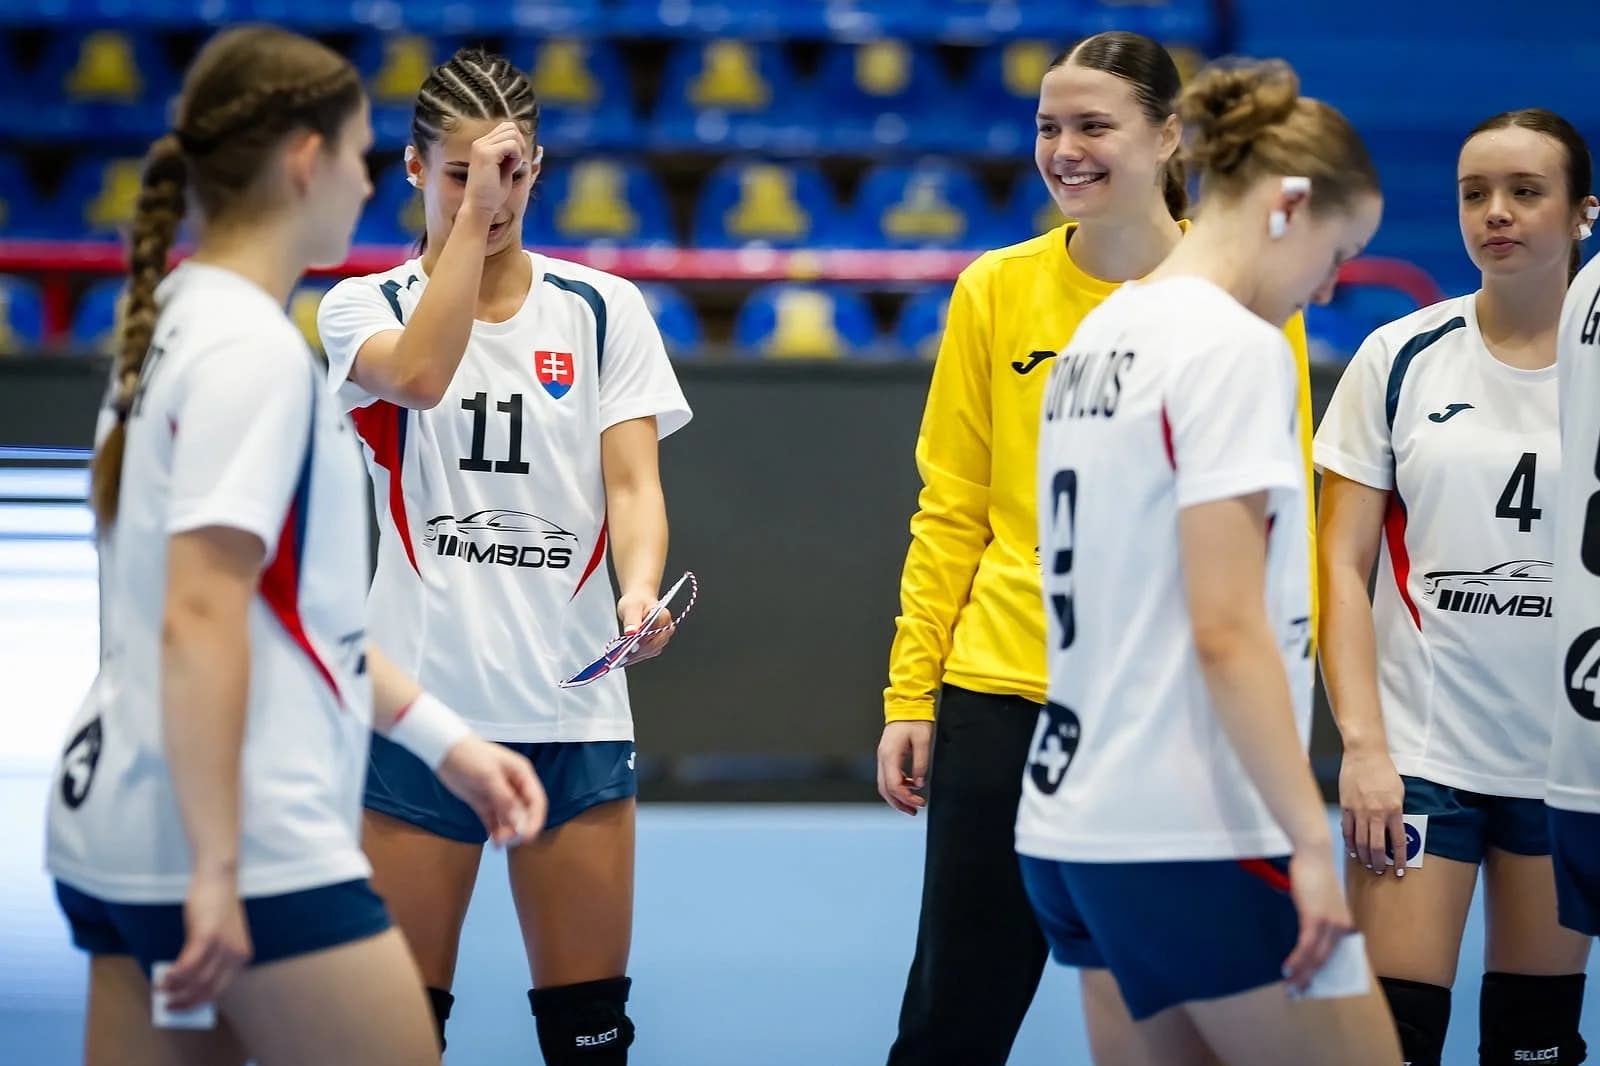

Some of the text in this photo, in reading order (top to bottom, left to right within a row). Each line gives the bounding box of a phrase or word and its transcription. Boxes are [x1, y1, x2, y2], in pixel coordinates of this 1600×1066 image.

[459, 392, 529, 474] 11
[1495, 452, 1541, 533] 4
[467, 541, 573, 569] MBDS
[1483, 593, 1552, 618] MB
[576, 1027, 618, 1047] SELECT
[1514, 1046, 1559, 1061] SELECT
